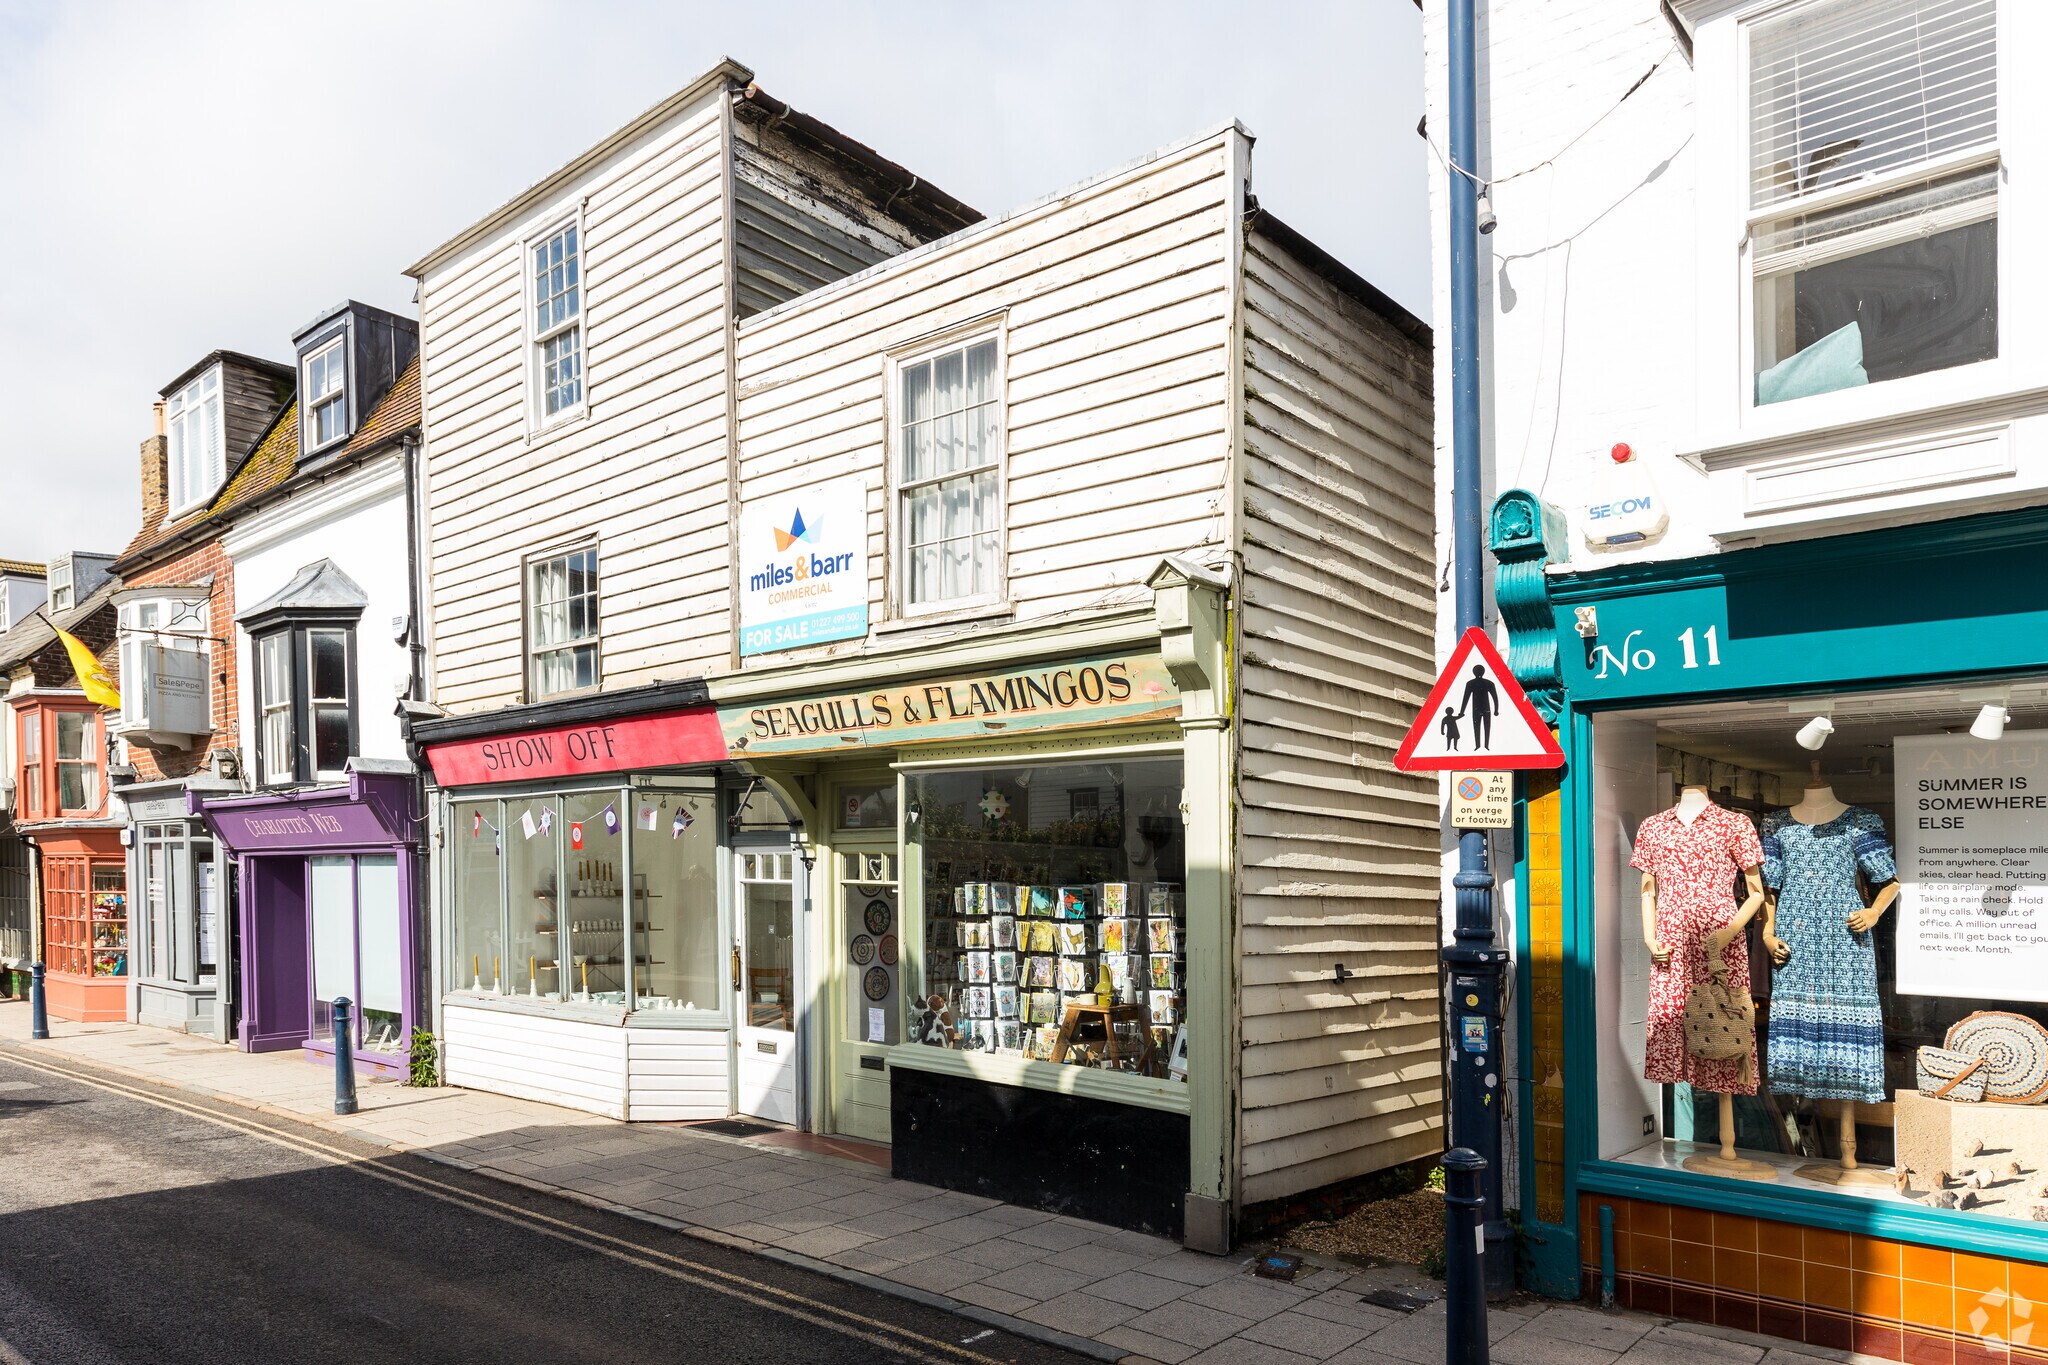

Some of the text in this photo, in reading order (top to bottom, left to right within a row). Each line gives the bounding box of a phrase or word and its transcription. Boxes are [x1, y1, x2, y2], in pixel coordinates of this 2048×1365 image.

[1590, 496, 1651, 520] SECOM
[768, 582, 832, 605] COMMERCIAL
[745, 621, 808, 649] FOR SALE
[1589, 624, 1721, 679] No 11
[158, 677, 200, 690] Sale&Pepe
[750, 662, 1132, 740] SEAGULLS & FLAMINGOS
[482, 727, 615, 771] SHOW OFF
[1492, 775, 1503, 783] At
[1918, 776, 2027, 792] SUMMER IS
[1489, 786, 1506, 795] any
[1918, 796, 2048, 811] SOMEWHERE
[1475, 807, 1502, 816] verge
[309, 813, 343, 836] WEB
[1468, 815, 1508, 826] footway
[1919, 817, 1964, 829] ELSE
[1918, 846, 1959, 854] Summer
[1961, 846, 1970, 854] is
[1972, 846, 2027, 855] someplace
[1918, 858, 2030, 868] from anywhere. Clear
[1918, 871, 2047, 881] skies, clear head. Putting
[1919, 882, 1934, 890] life
[1952, 883, 1993, 892] airplane
[1995, 884, 2026, 892] mode.
[1919, 894, 1949, 904] Taking
[1982, 896, 2016, 904] check.
[2018, 896, 2043, 904] Hold
[1919, 907, 1930, 915] all
[1976, 908, 1998, 918] Way
[1919, 919, 1952, 927] office.
[1966, 920, 1997, 928] million
[2000, 922, 2037, 930] unread
[1919, 932, 2048, 944] emails. I'll get back to you
[1919, 944, 2013, 954] next week. Month.
